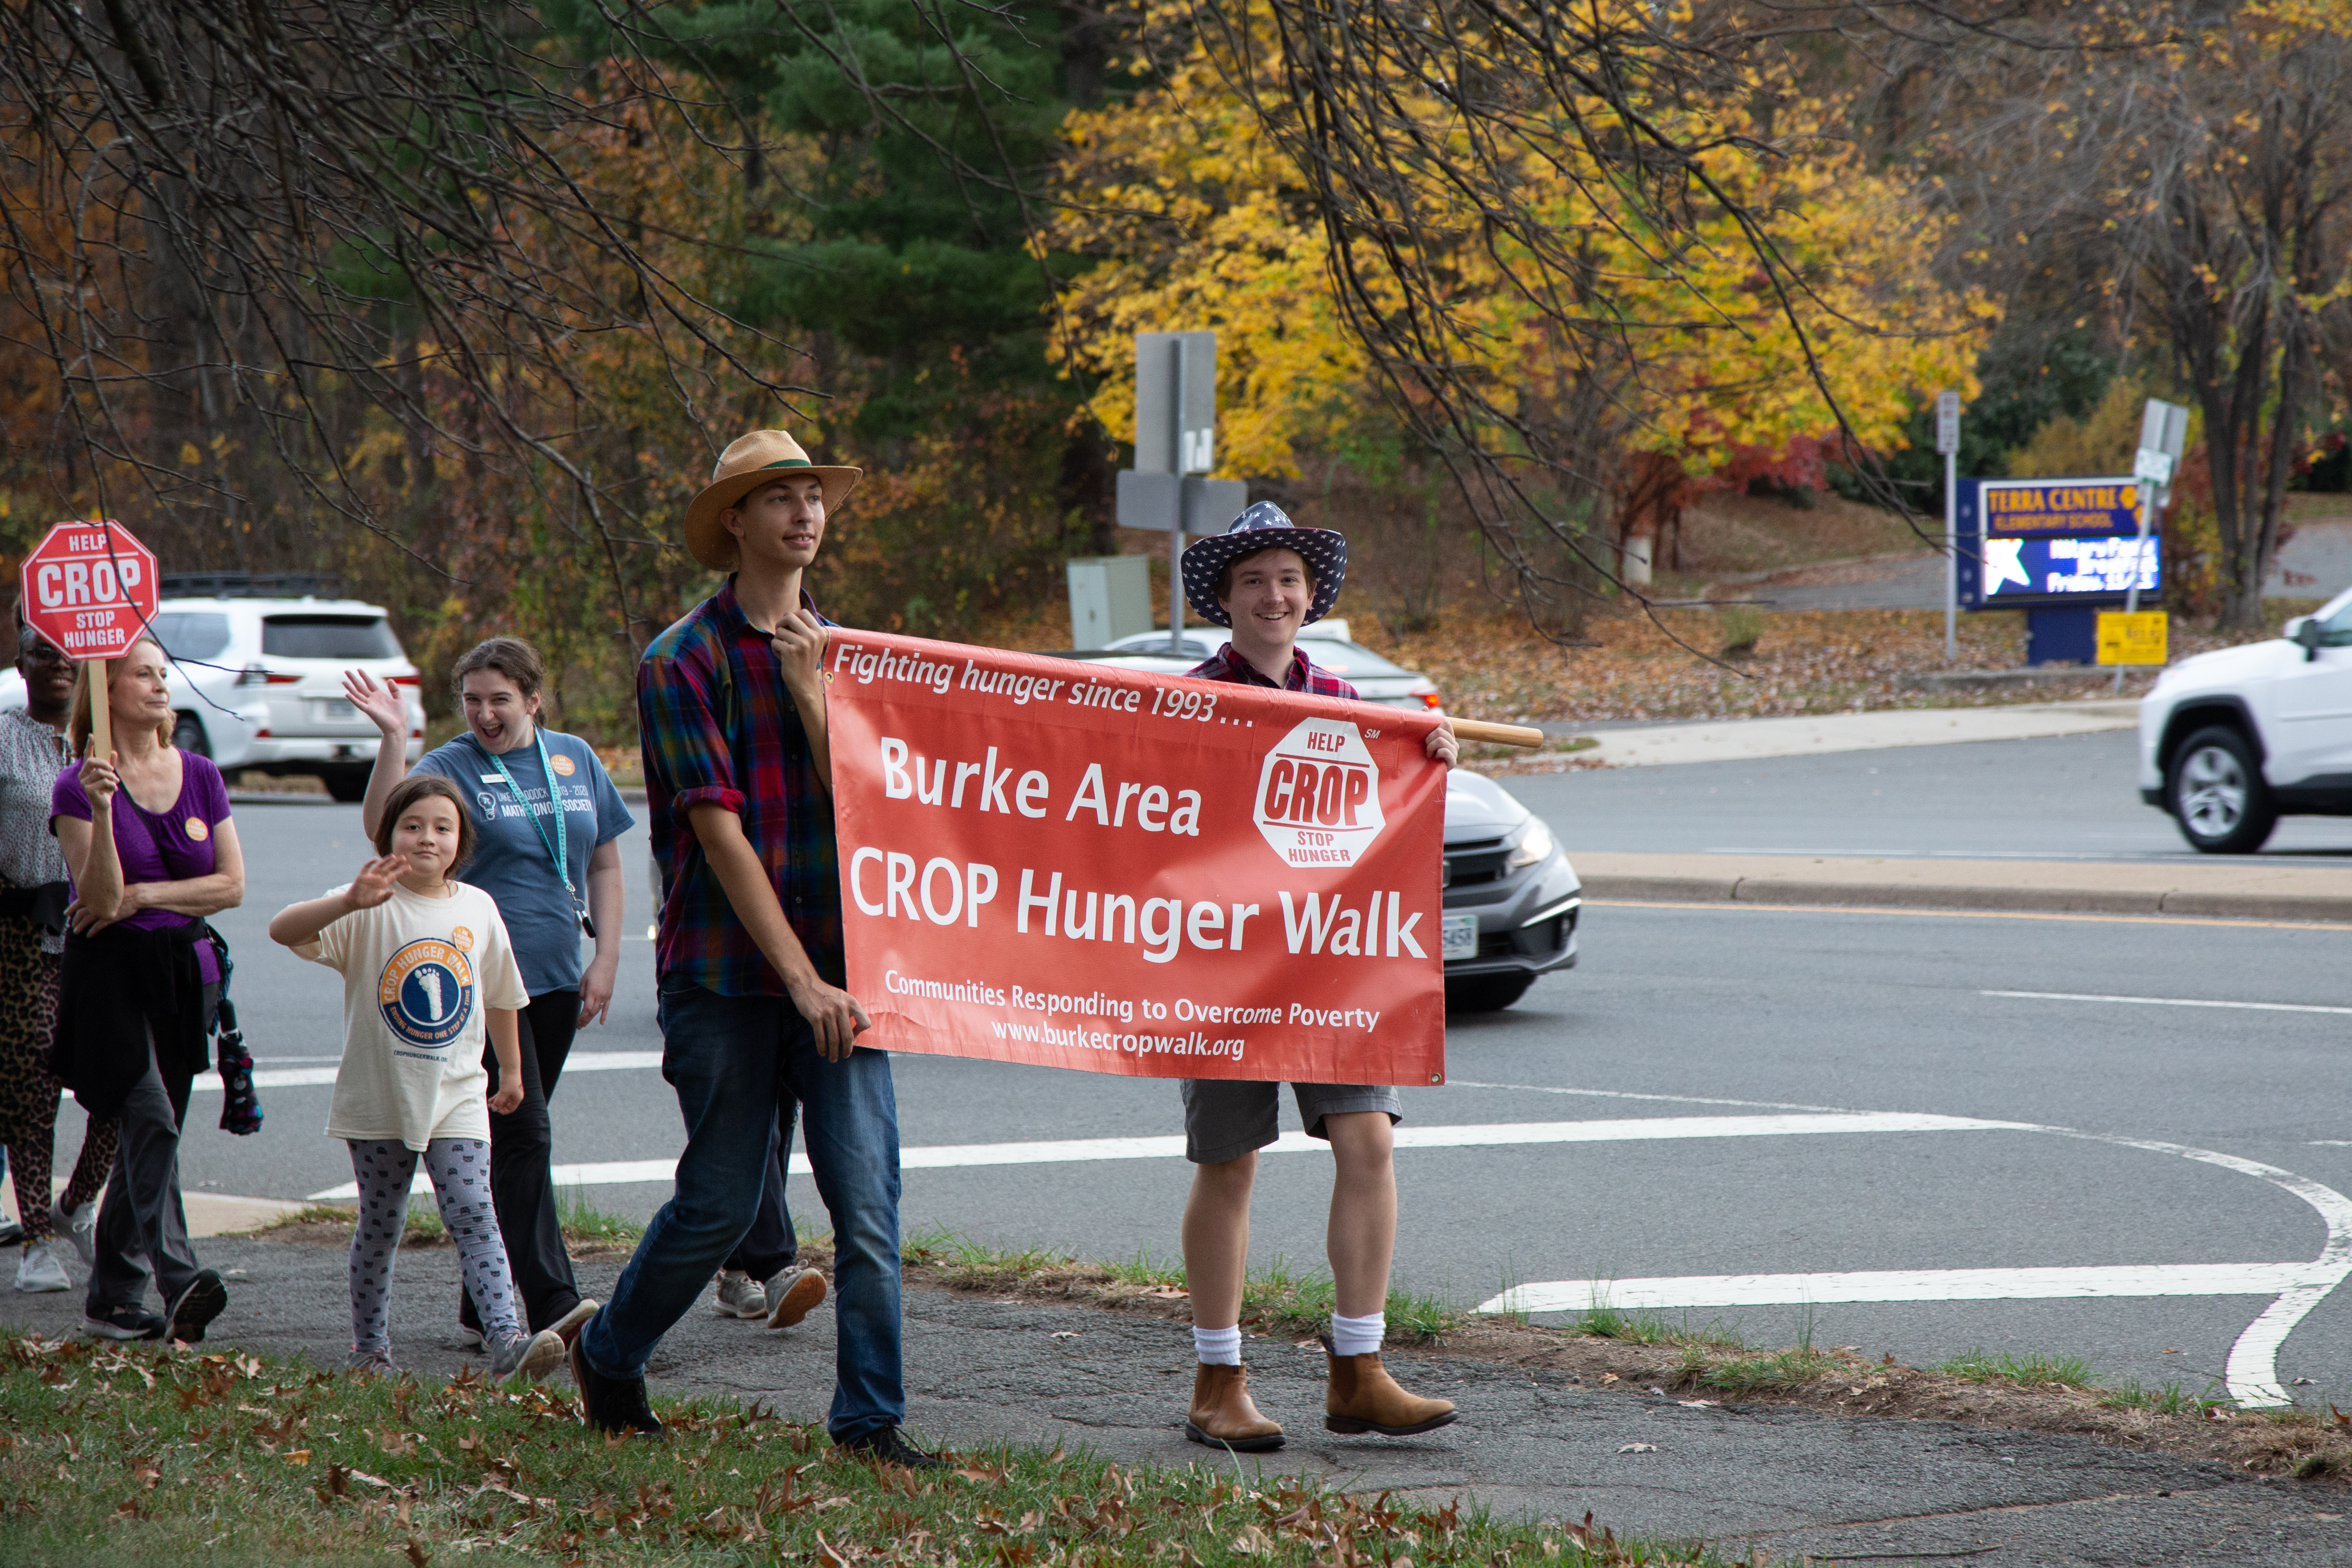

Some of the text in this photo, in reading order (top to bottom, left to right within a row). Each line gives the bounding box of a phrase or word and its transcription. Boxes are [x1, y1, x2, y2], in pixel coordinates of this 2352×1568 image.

[1989, 487, 2117, 513] TERRA CENTRE
[69, 534, 107, 551] HELP
[37, 559, 141, 607] CROP
[76, 611, 115, 629] STOP
[64, 628, 125, 648] HUNGER
[834, 644, 954, 694] Fighting
[960, 659, 1065, 705] hunger
[1068, 678, 1140, 712] since
[1307, 731, 1345, 752] HELP
[1365, 729, 1381, 739] SM
[572, 785, 588, 796] 2020
[881, 736, 1201, 836] Burke Area
[1264, 759, 1369, 826] CROP
[501, 799, 593, 817] MATH ONO SOCIETY
[1298, 831, 1334, 846] STOP
[1288, 848, 1351, 862] HUNGER
[851, 847, 1428, 963] CROP Hunger Walk
[384, 946, 469, 1001] CROP HUNGER WALK
[885, 970, 1380, 1033] Communities Responding to Overcome Poverty
[390, 1006, 407, 1029] ENDING
[406, 1027, 433, 1039] HUNGER
[435, 1030, 448, 1039] ONE
[448, 1021, 460, 1034] STEP
[459, 1014, 465, 1022] AT
[991, 1021, 1245, 1060] www.burkecropwalk.org
